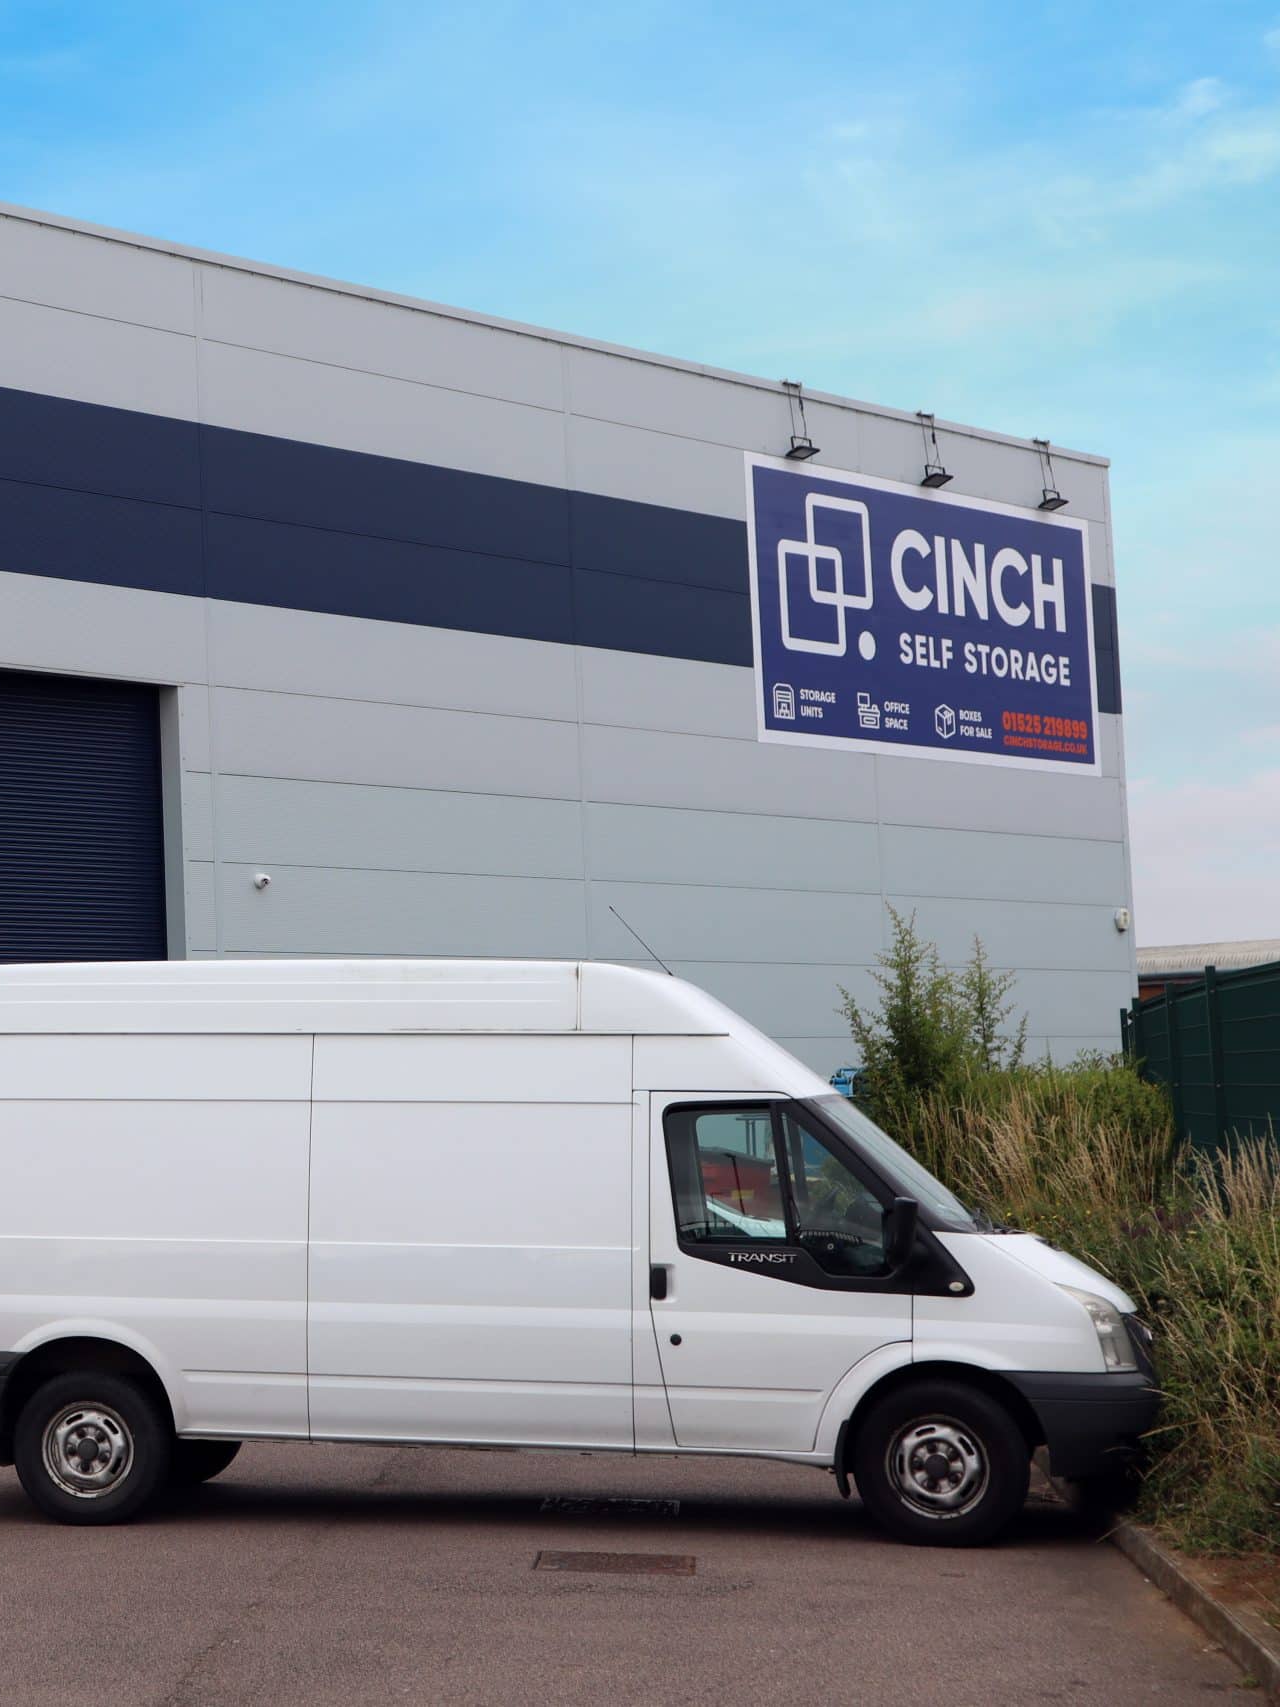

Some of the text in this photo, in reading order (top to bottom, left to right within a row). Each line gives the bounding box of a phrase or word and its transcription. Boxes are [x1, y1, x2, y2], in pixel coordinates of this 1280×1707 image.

[891, 529, 1066, 633] CINCH
[899, 632, 1071, 686] SELF STORAGE
[800, 689, 836, 703] STORAGE
[801, 705, 823, 718] UNITS
[884, 701, 910, 714] OFFICE
[960, 709, 982, 722] BOXES
[885, 717, 908, 730] SPACE
[1002, 711, 1041, 734] 01525
[960, 725, 992, 739] FOR SALE
[728, 1252, 797, 1264] TRANSIT
